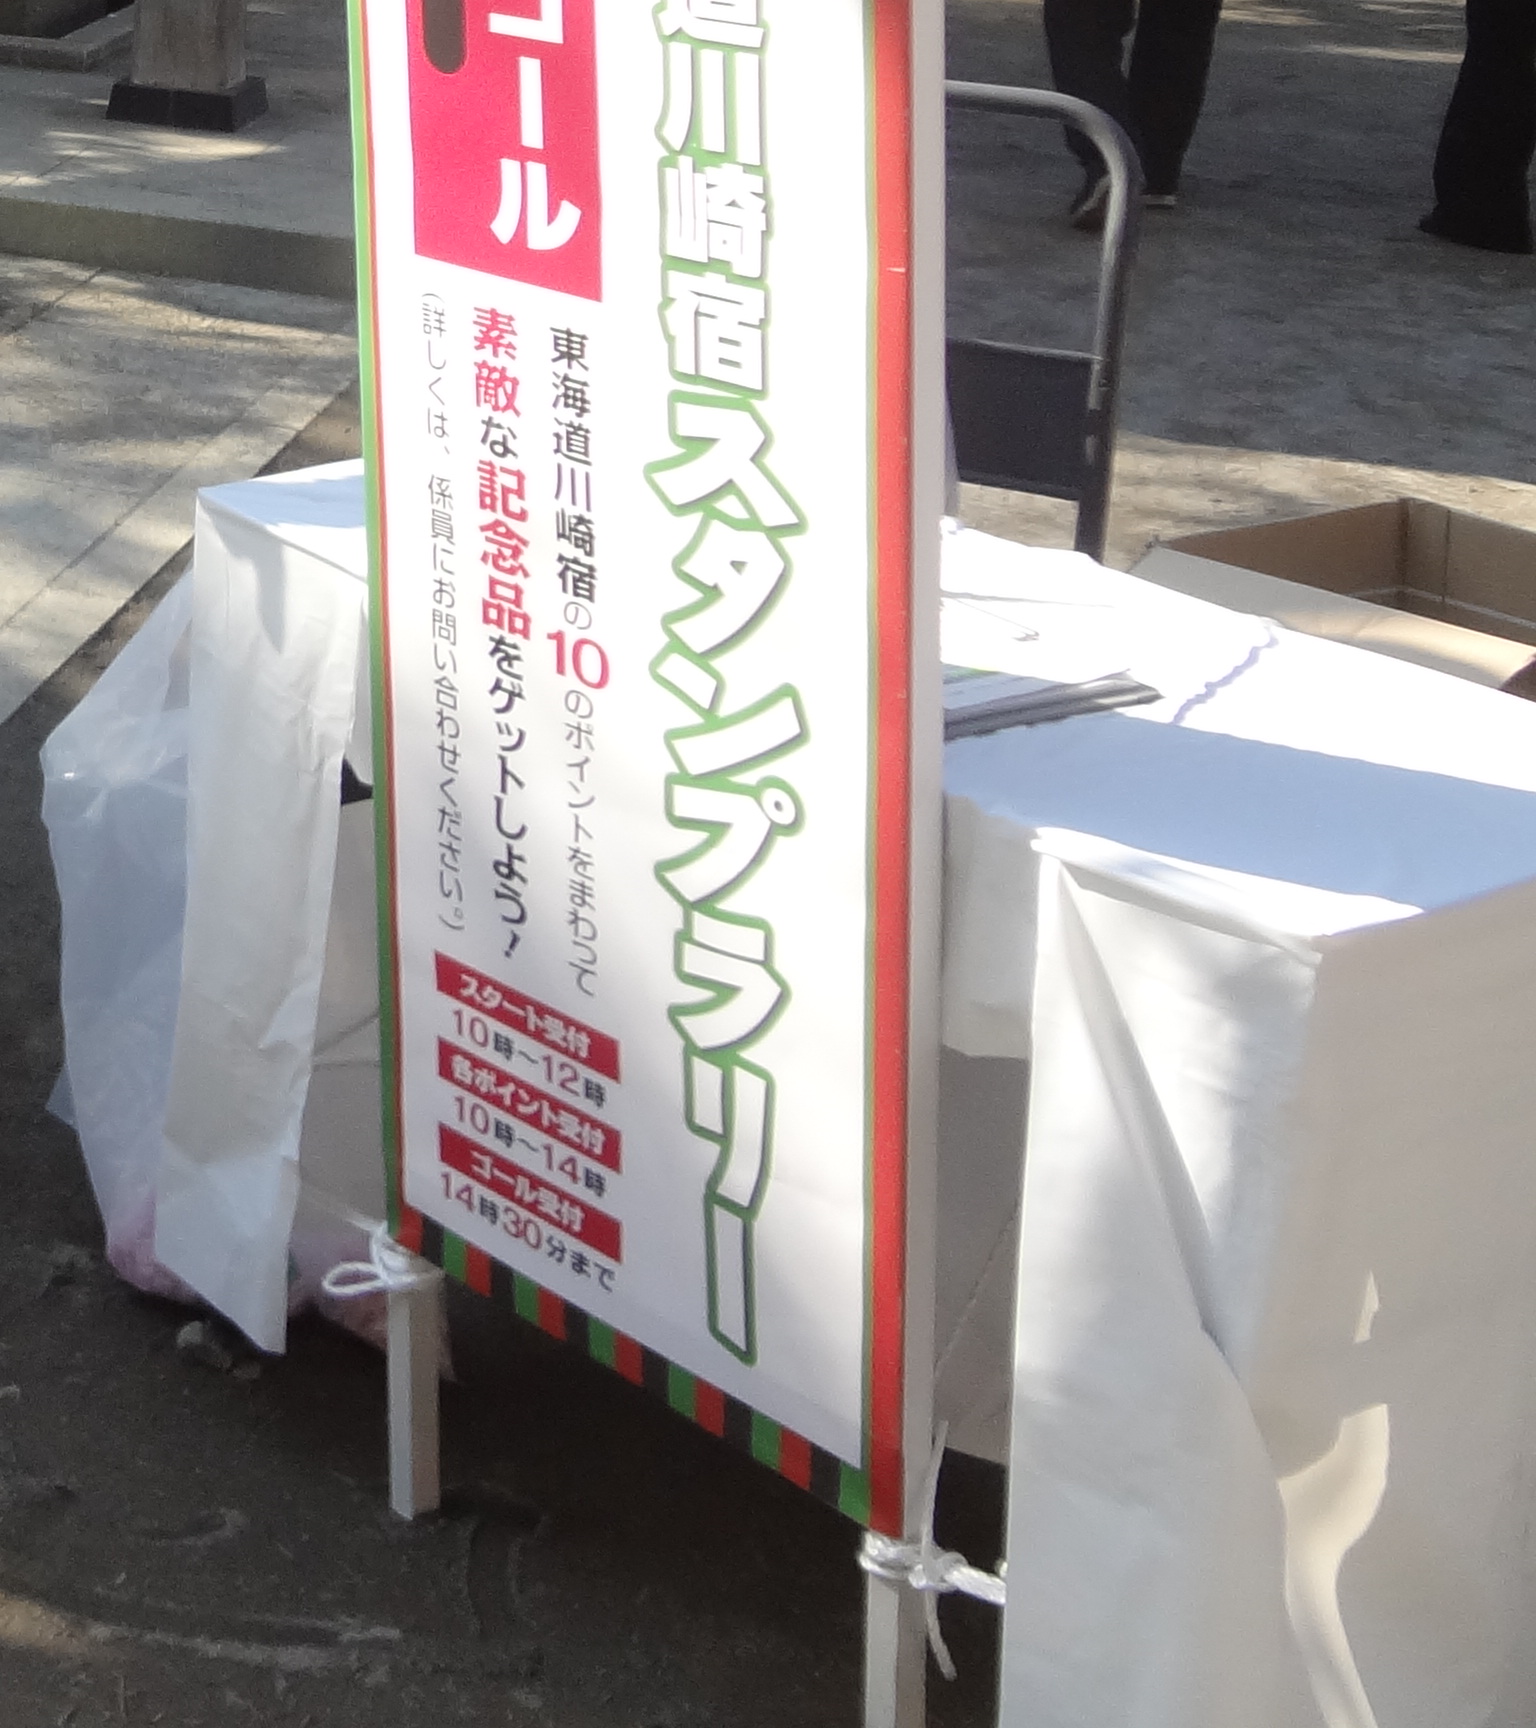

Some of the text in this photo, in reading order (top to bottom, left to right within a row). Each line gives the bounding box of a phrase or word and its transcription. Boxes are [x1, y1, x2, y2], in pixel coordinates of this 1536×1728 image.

[459, 973, 592, 1059] スタート受付
[450, 1054, 605, 1156] 各ポイント受付
[440, 1172, 616, 1294] 14時30分まで
[470, 1150, 585, 1232] ゴール受付
